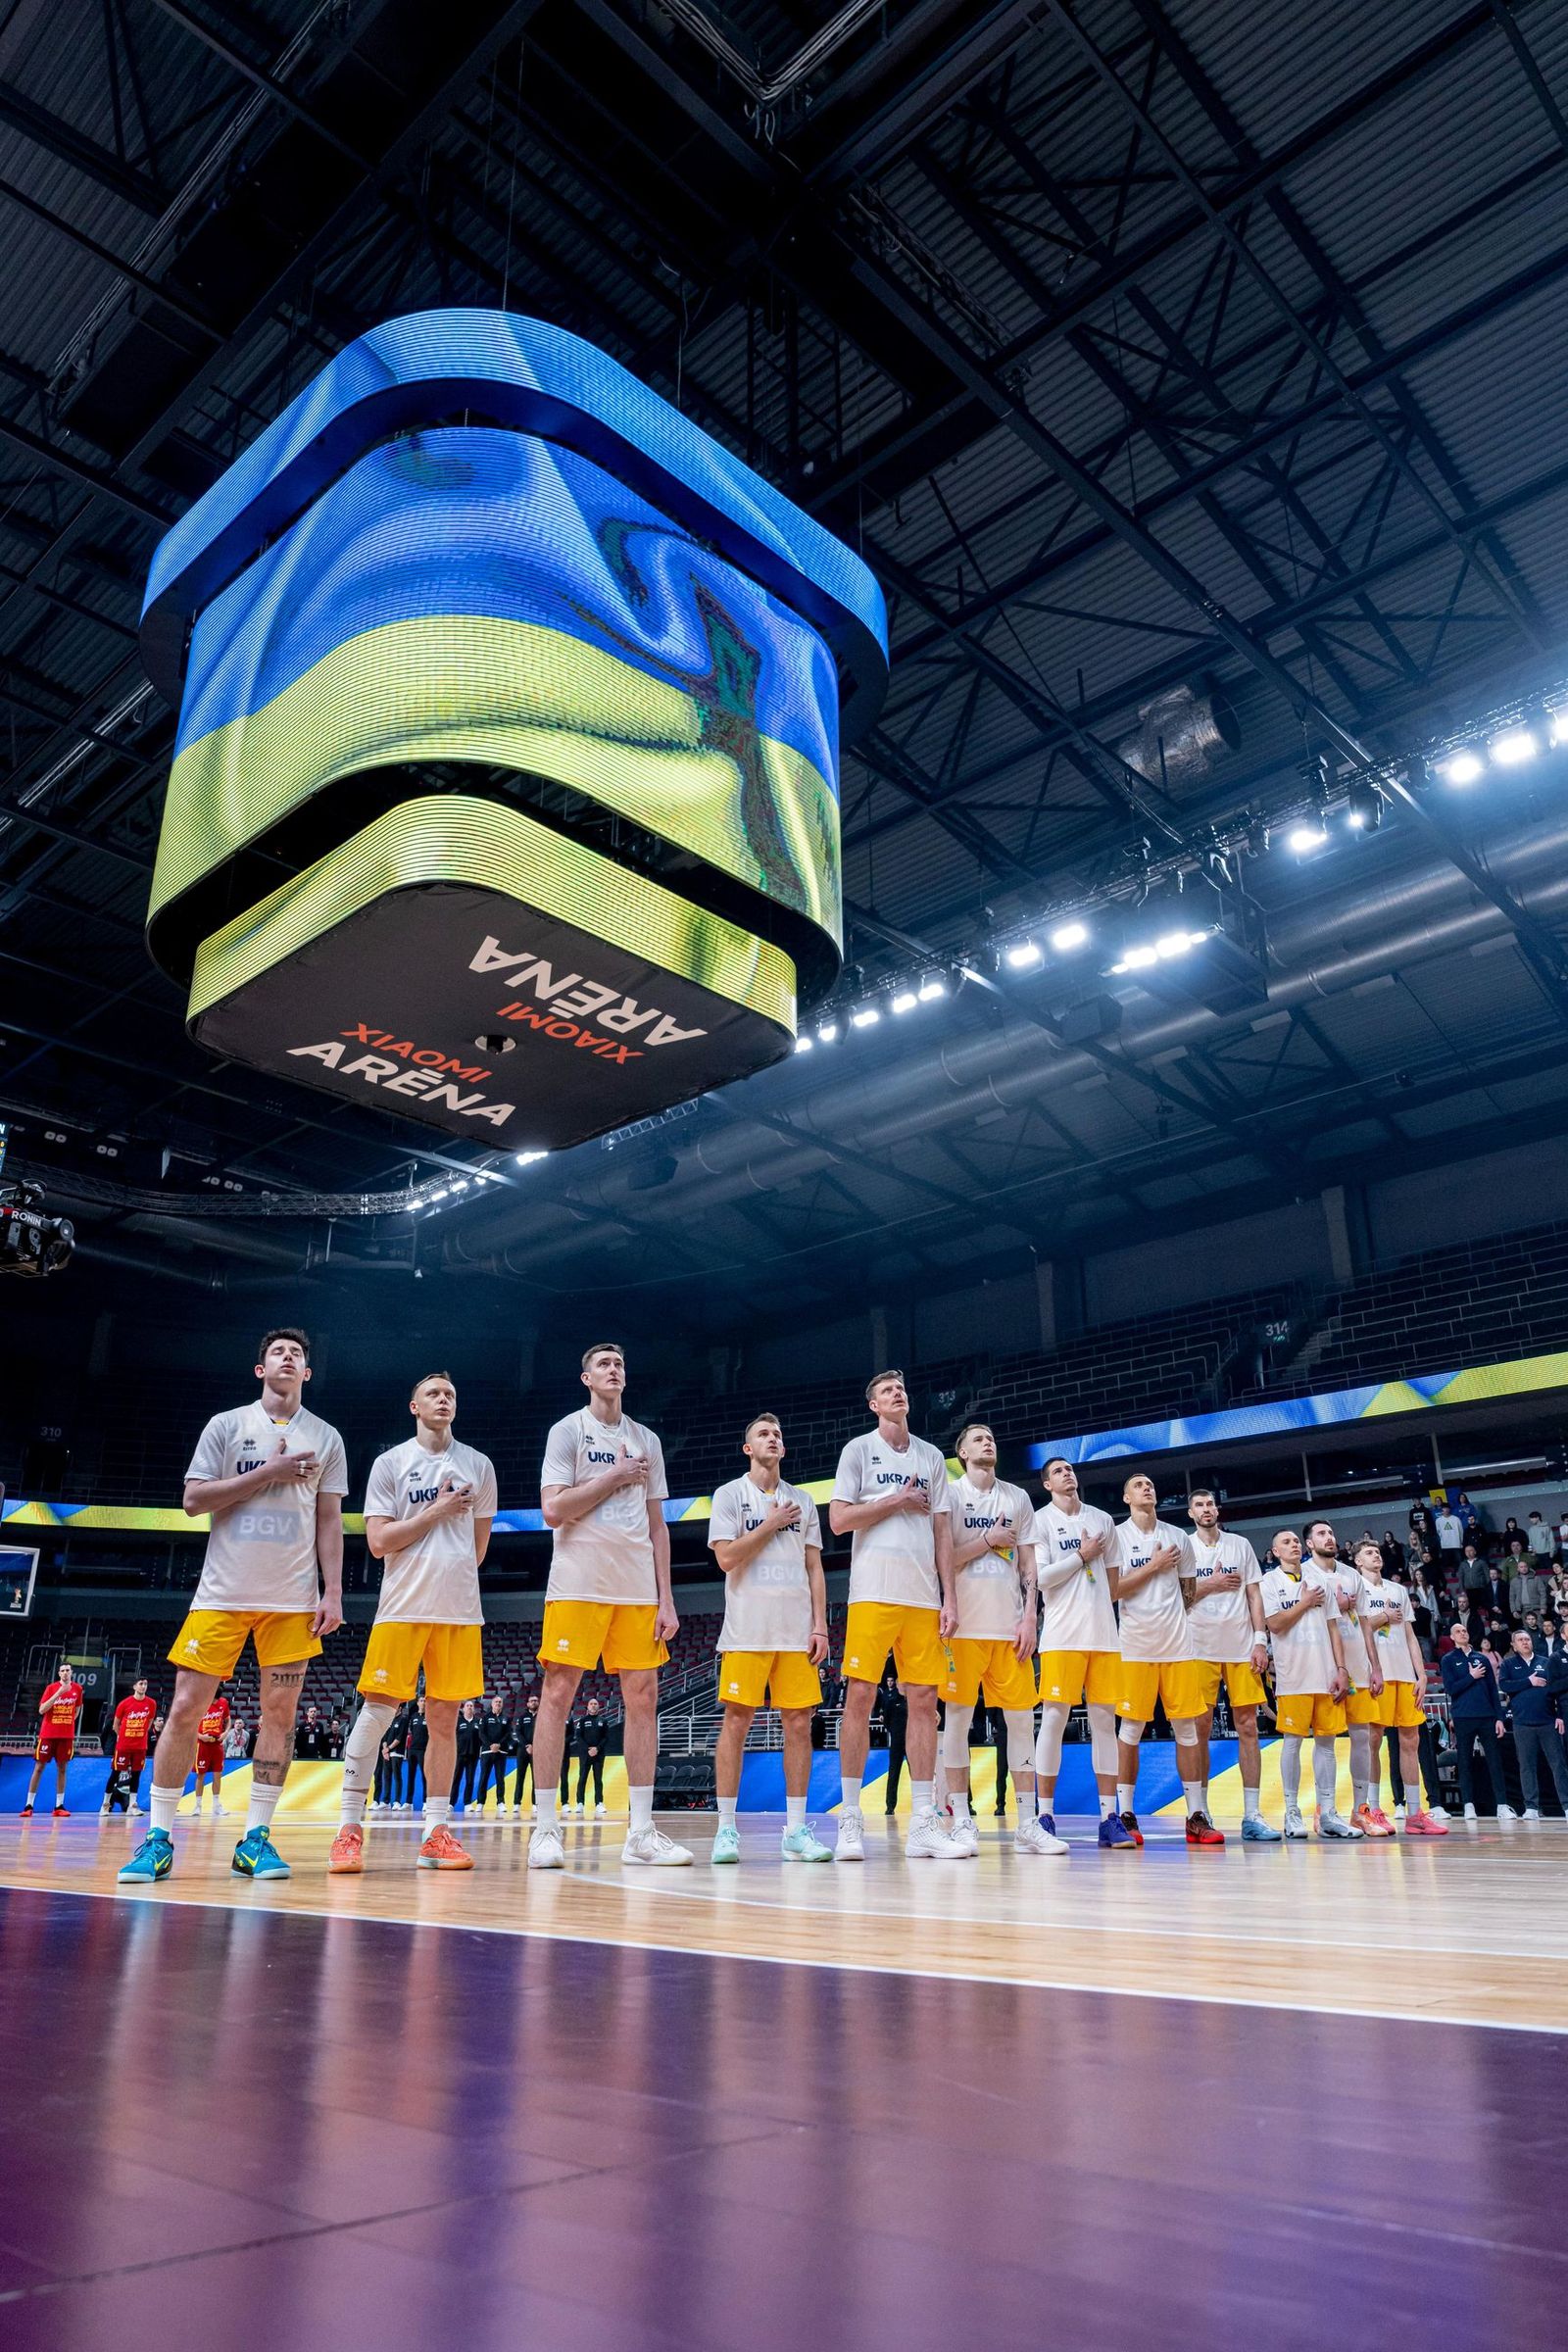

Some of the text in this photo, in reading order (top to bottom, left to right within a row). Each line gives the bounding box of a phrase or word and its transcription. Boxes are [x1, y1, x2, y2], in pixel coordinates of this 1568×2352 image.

[468, 935, 708, 1047] ARĒNA
[340, 1022, 493, 1084] XIAOMI
[496, 1002, 646, 1065] XIAOMI
[285, 1041, 517, 1126] ARĒNA
[12, 1210, 41, 1227] RONIN
[1265, 1320, 1289, 1337] 314
[239, 1515, 294, 1537] BGV
